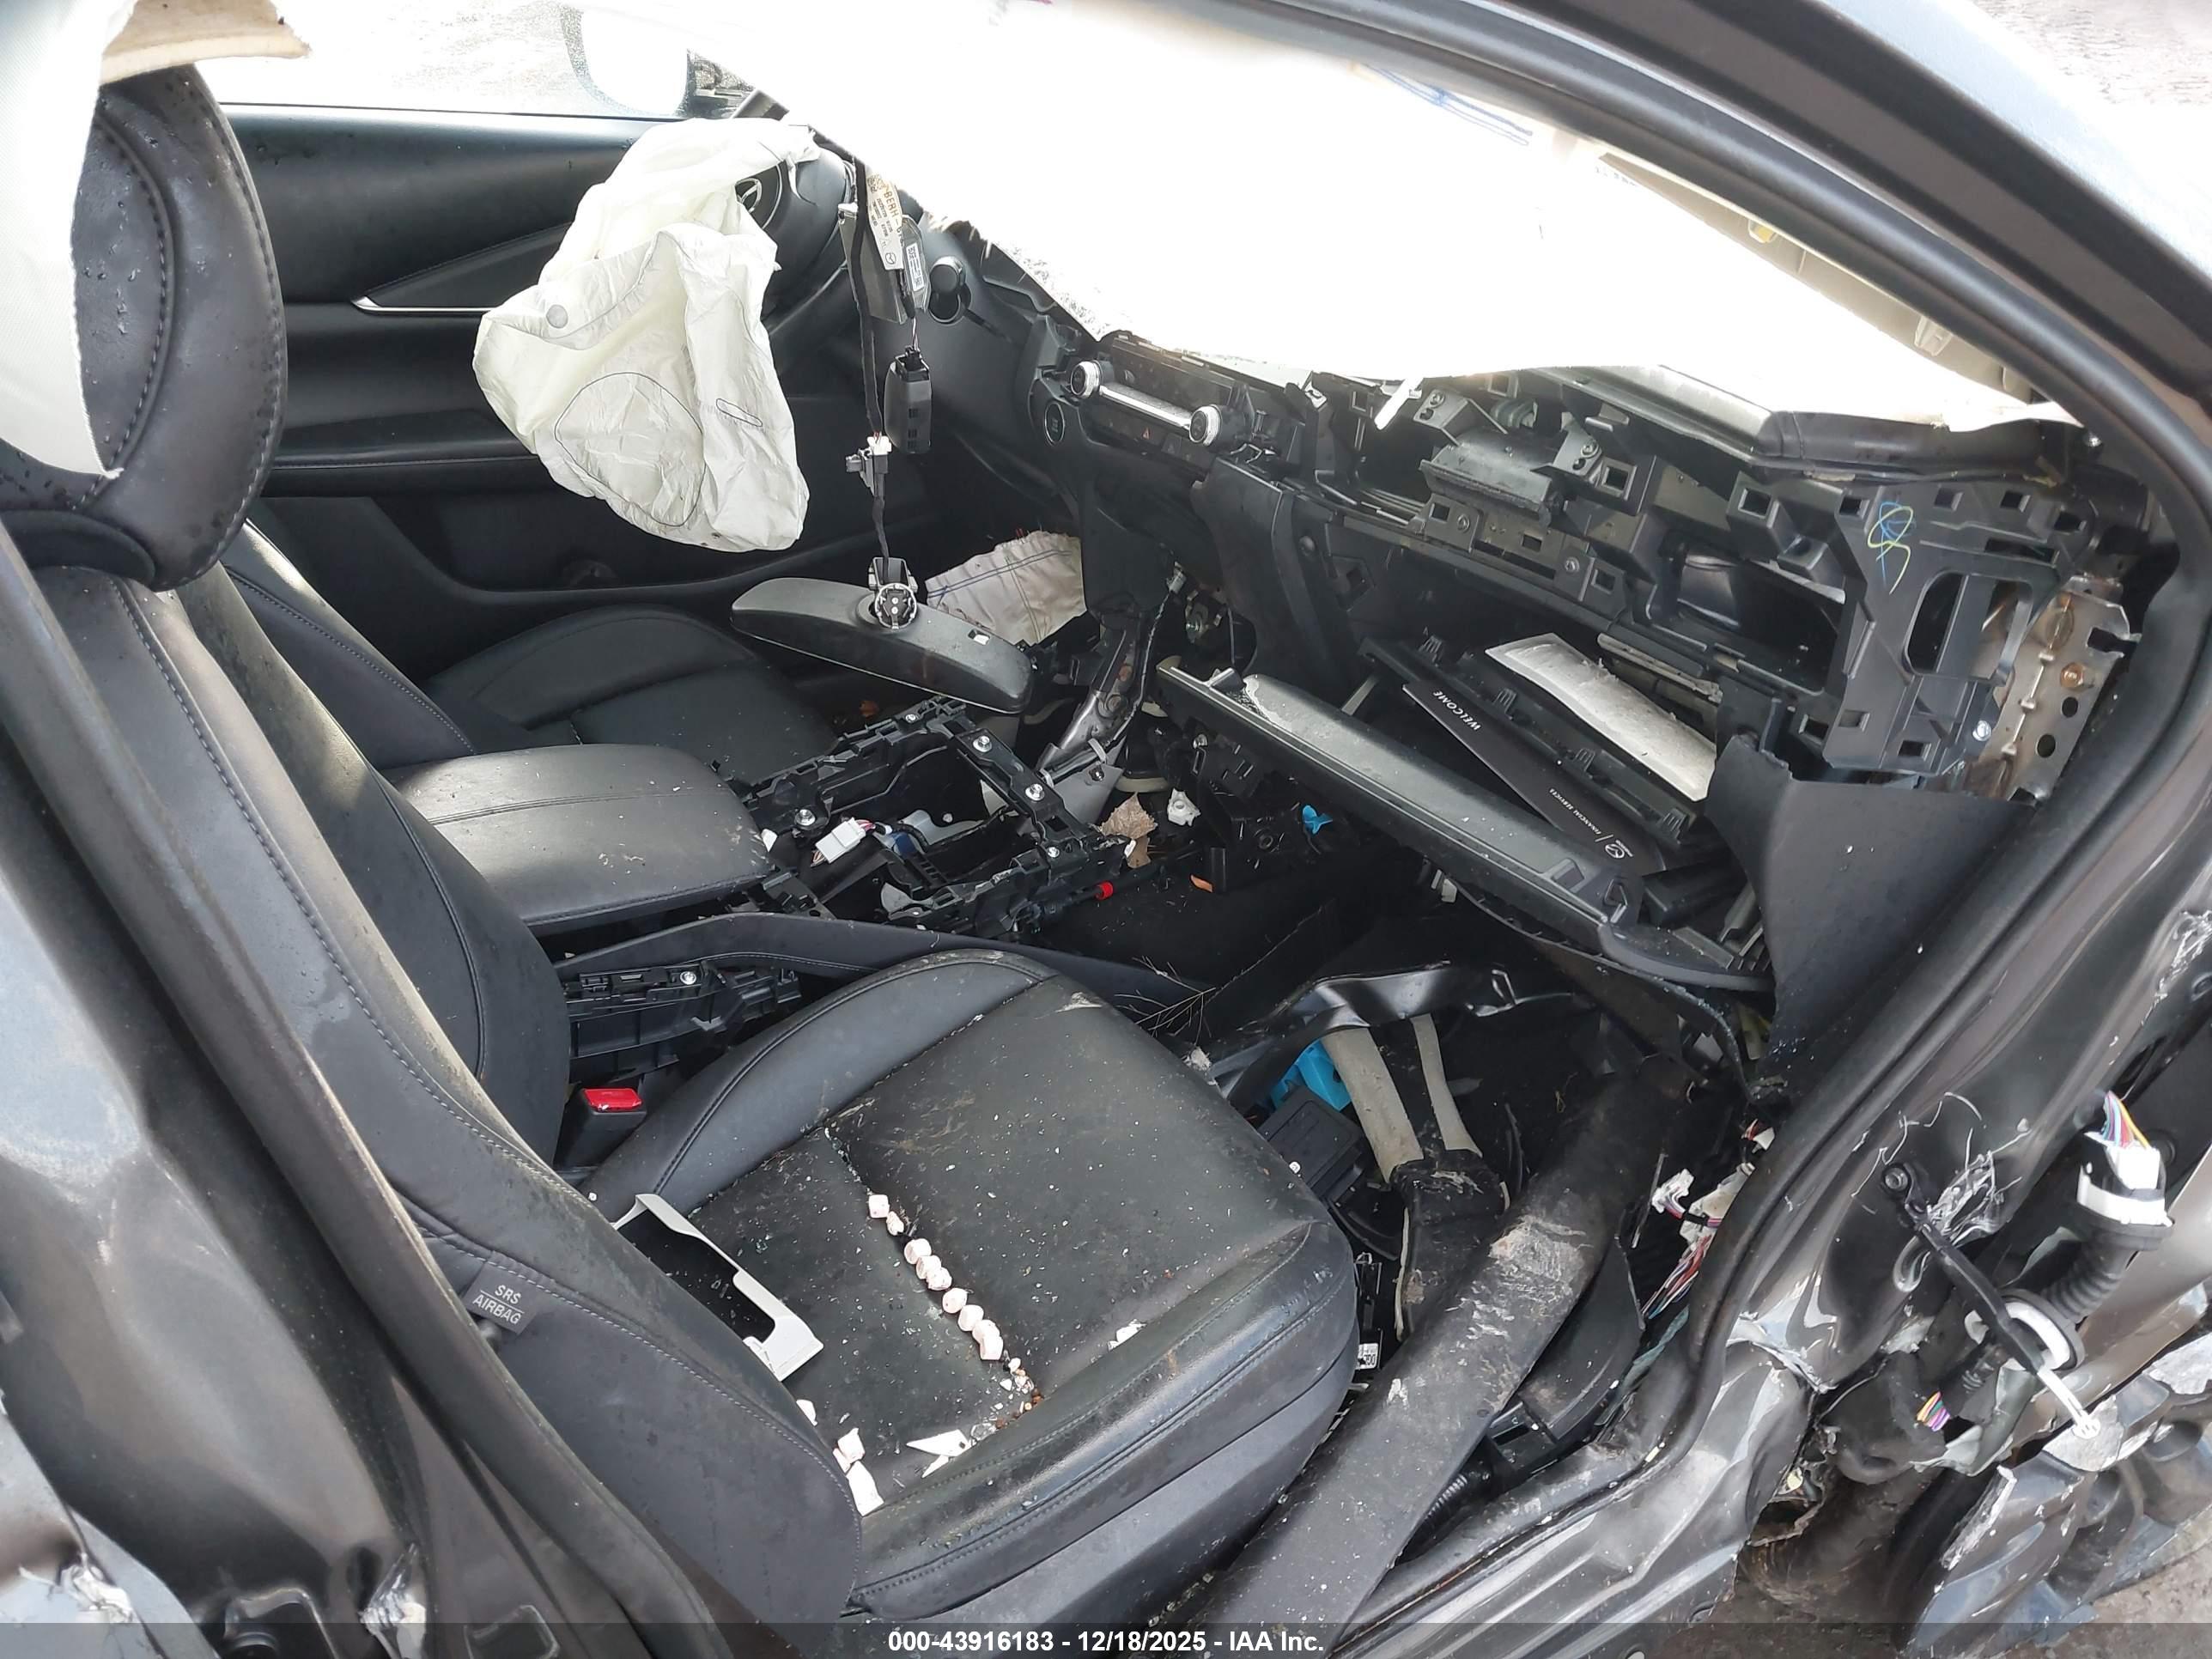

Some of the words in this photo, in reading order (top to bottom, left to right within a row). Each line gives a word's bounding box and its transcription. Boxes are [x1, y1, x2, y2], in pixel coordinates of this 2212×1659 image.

[1432, 690, 1481, 731] WELCOME
[1548, 787, 1575, 811] SERVICES
[1573, 809, 1602, 836] FINANCIAL
[495, 1285, 521, 1304] SRS
[472, 1294, 521, 1324] AIRBAG
